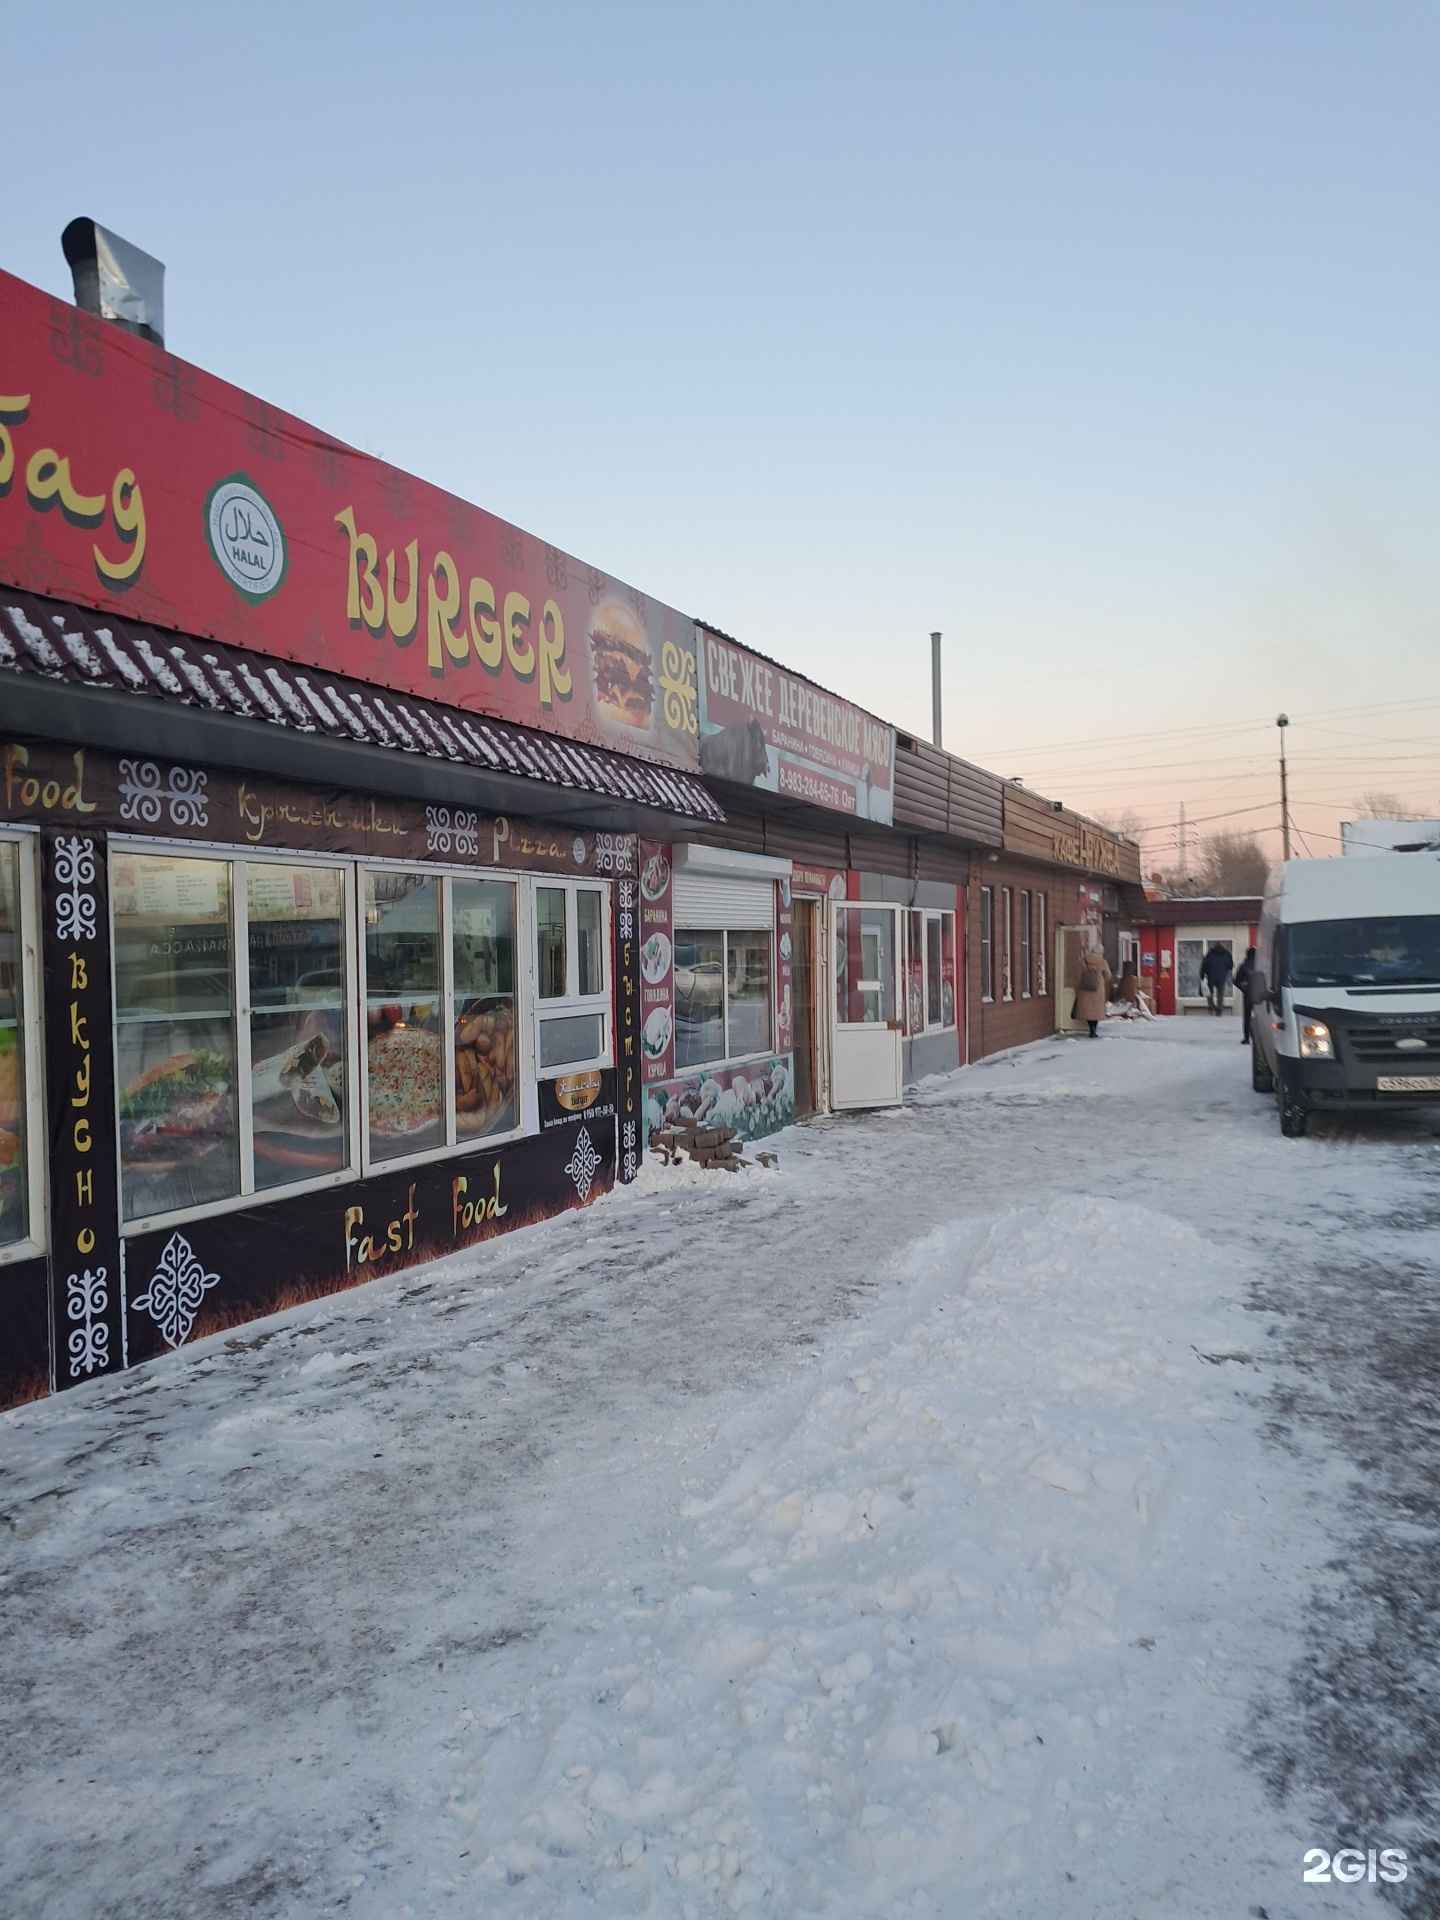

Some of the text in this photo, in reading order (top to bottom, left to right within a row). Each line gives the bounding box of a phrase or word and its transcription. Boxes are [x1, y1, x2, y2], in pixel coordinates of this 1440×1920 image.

[225, 506, 269, 547] حلال
[232, 546, 266, 570] HALAL
[706, 639, 890, 767] СВЕЖЕЕ ДЕРЕВЕНСКОЕ МЯСО
[5, 744, 97, 813] Food
[493, 815, 567, 863] Pizza
[344, 1160, 508, 1273] Fast Food
